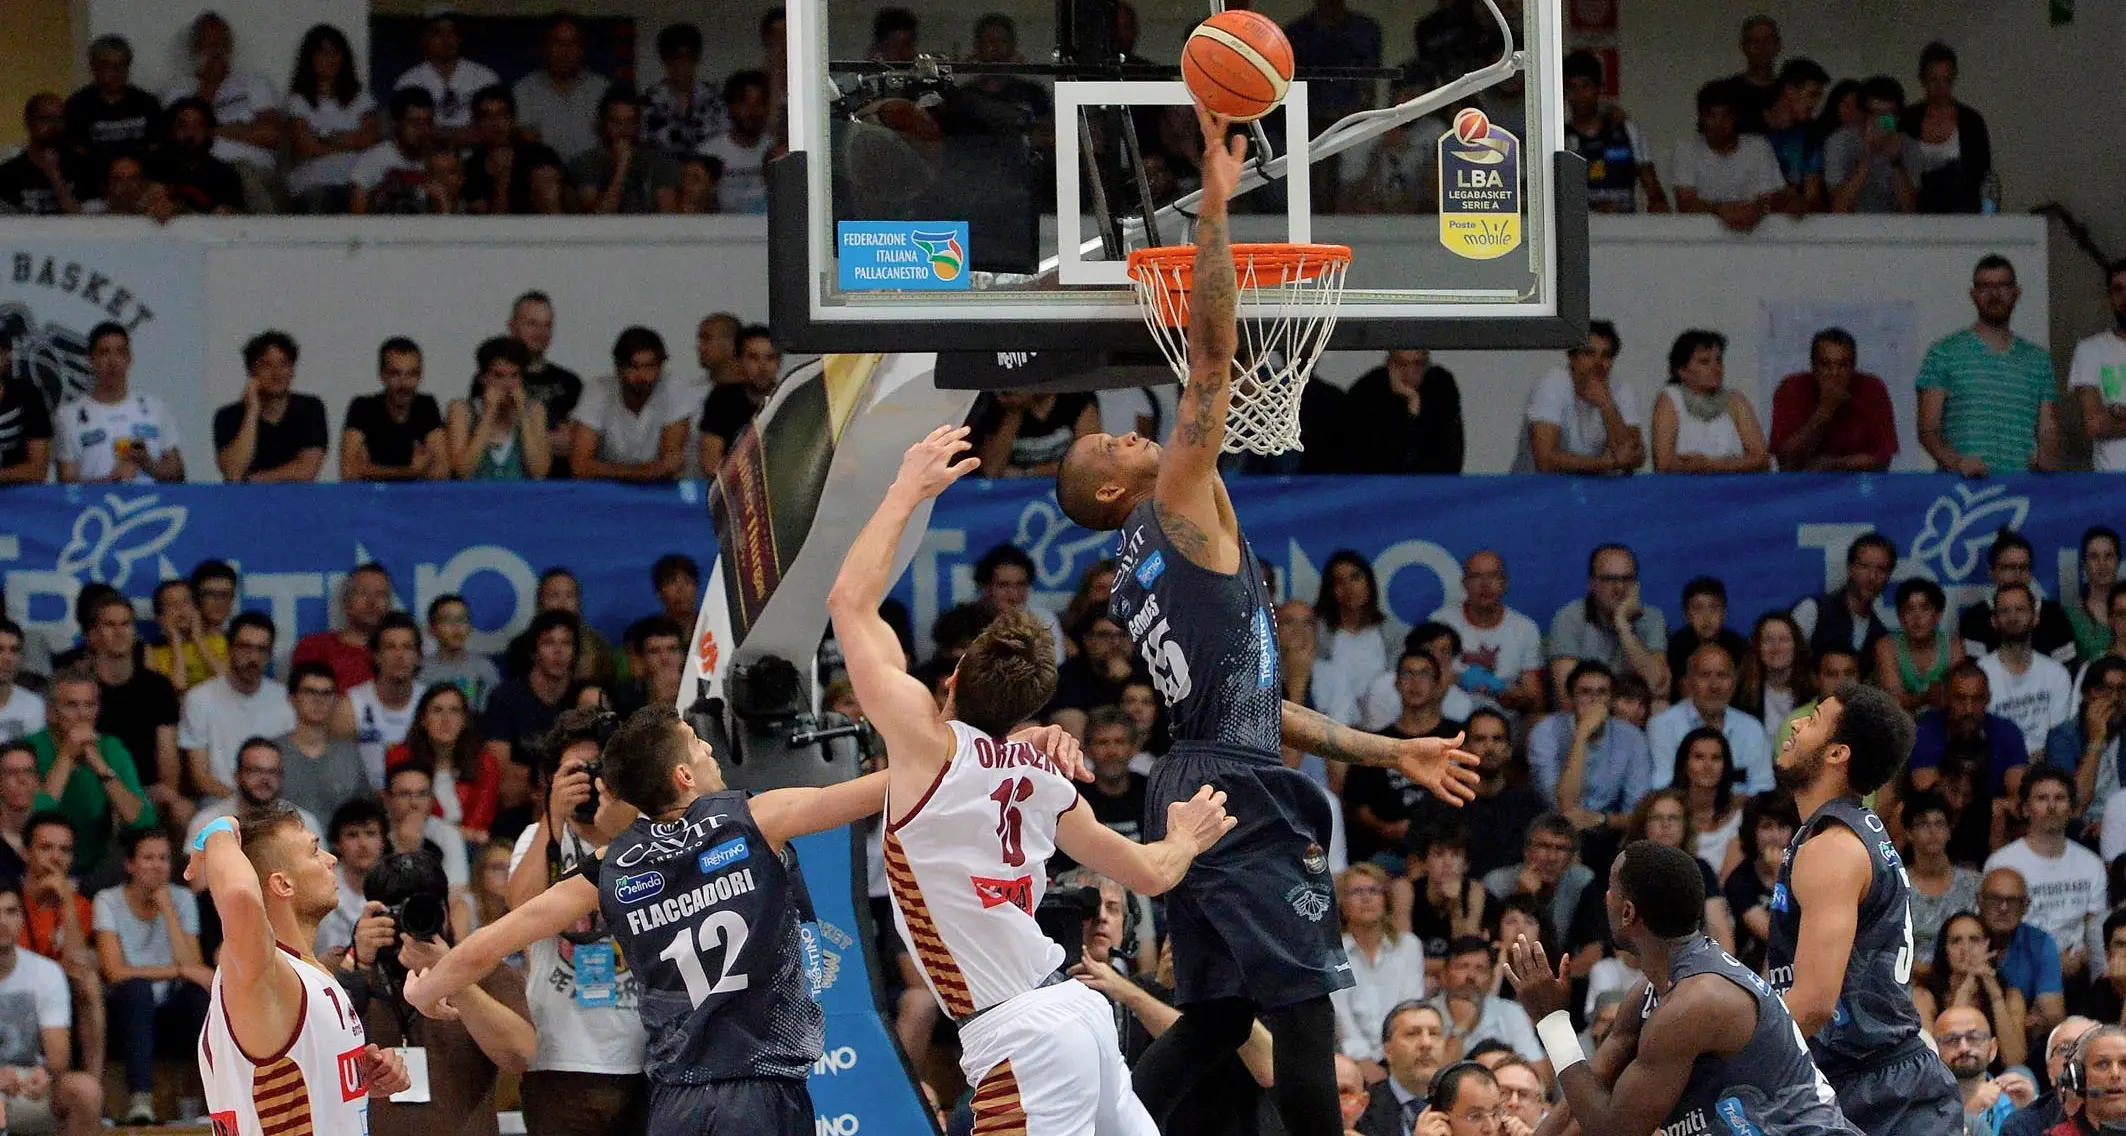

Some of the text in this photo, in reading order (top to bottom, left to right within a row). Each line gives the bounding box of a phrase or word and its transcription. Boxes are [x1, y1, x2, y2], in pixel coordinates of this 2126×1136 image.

[1457, 169, 1503, 188] LBA
[1448, 190, 1513, 200] LEGABASKET
[1461, 200, 1500, 210] SERIE A
[1448, 220, 1476, 229] Poste
[1463, 219, 1512, 245] mobile
[843, 233, 907, 246] FEDERAZIONE
[876, 249, 918, 263] ITALIANA
[854, 266, 929, 280] PALLACANESTRO
[12, 252, 154, 332] BASKET
[616, 813, 729, 868] CAVIT
[649, 840, 703, 865] TRENTO
[702, 843, 746, 869] TRENTINO
[618, 875, 662, 898] Melinda
[626, 867, 757, 936] FLACCADORI
[659, 909, 750, 1011] 12
[800, 927, 823, 999] TRENTINO
